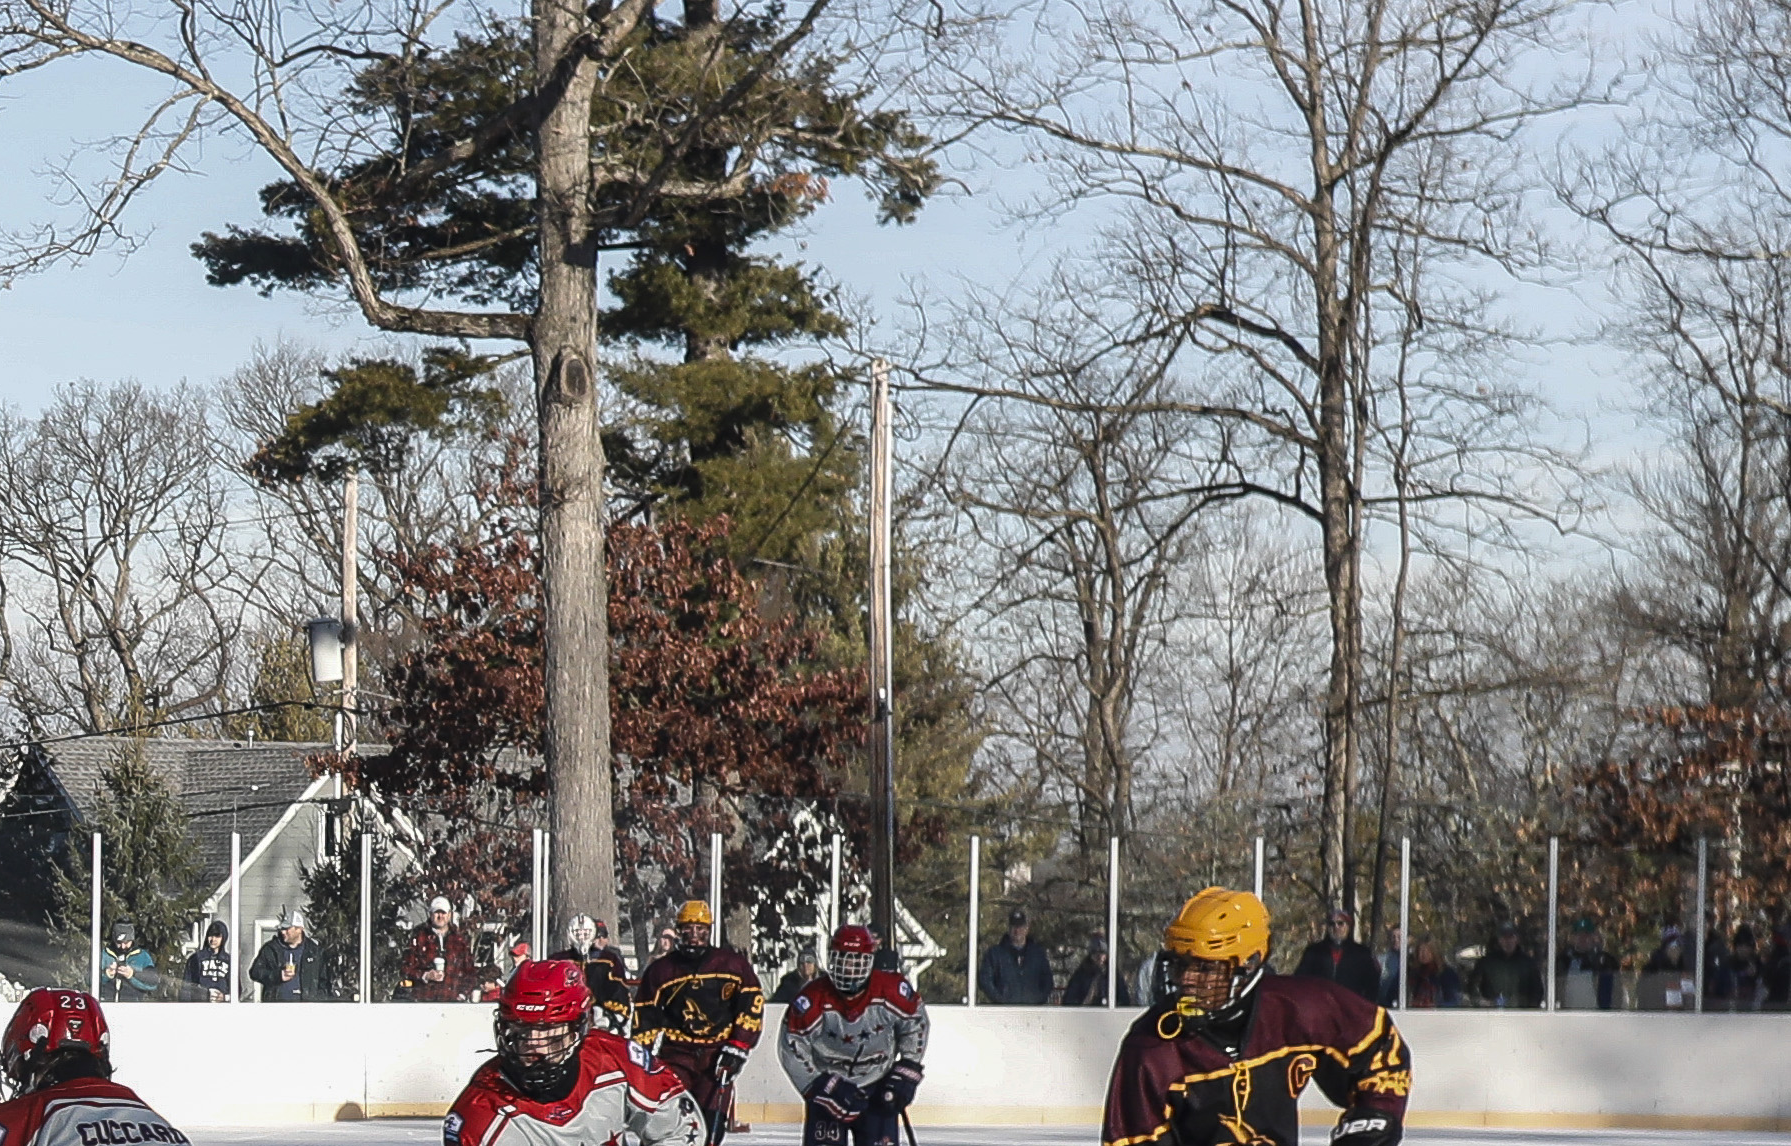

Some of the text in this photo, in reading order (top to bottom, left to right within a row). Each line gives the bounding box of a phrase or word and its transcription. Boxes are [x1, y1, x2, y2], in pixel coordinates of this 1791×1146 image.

[60, 995, 87, 1011] 23
[516, 1004, 537, 1012] CCM
[750, 995, 763, 1014] 9
[1288, 1053, 1316, 1099] C
[814, 1121, 840, 1141] 34
